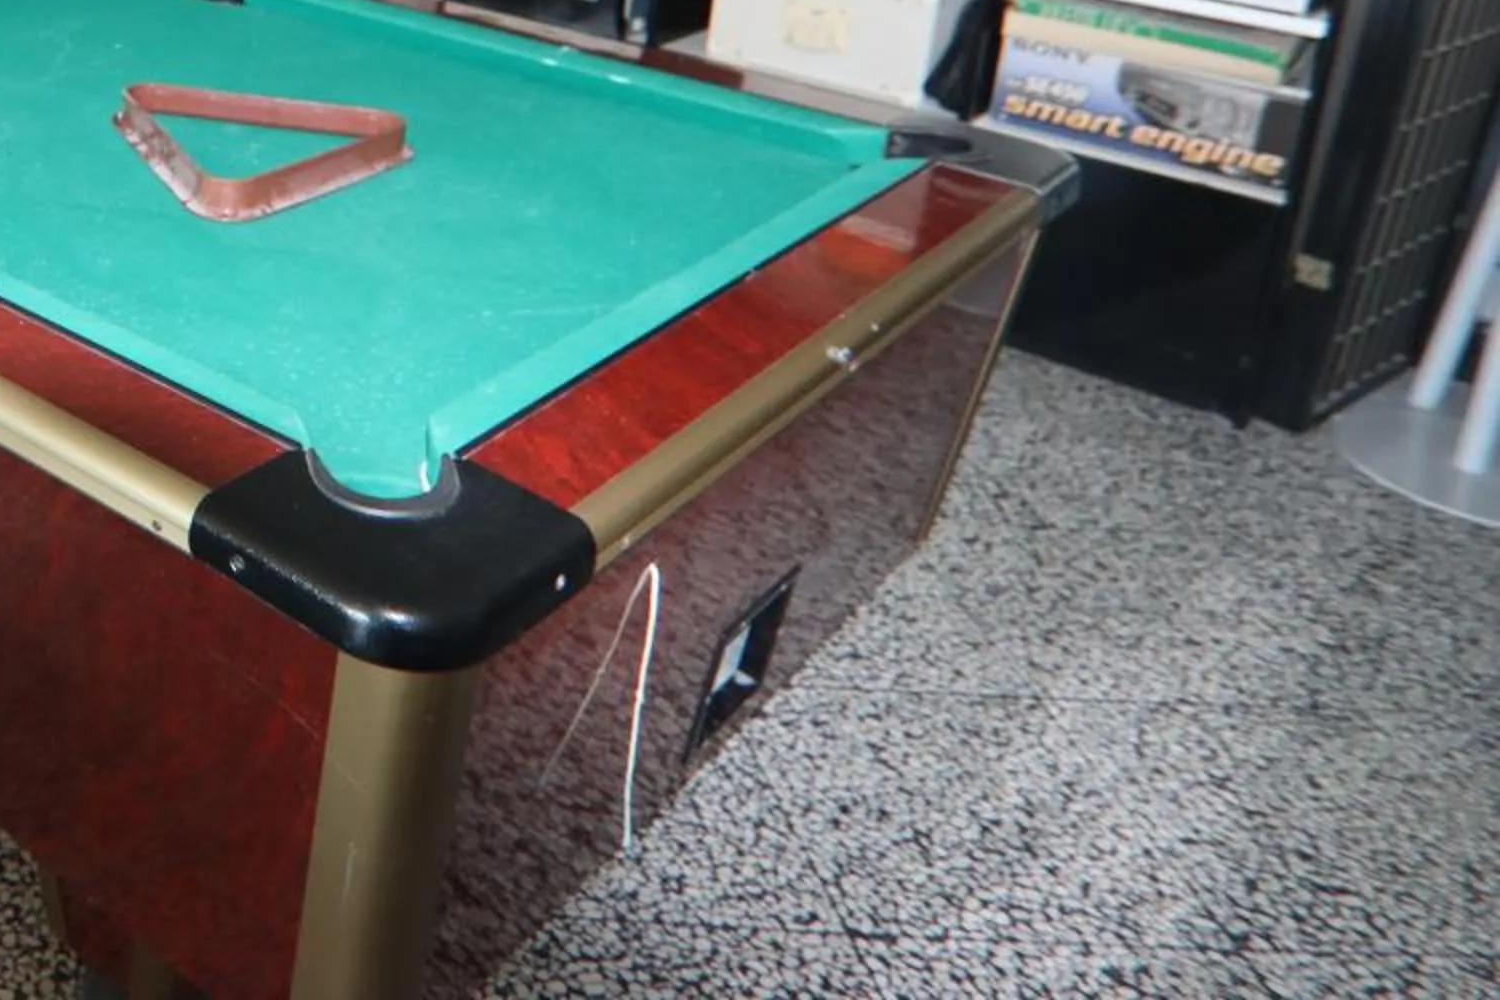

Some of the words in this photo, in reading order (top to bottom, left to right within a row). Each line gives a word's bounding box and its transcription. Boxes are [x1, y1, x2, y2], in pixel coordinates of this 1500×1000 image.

[1011, 35, 1091, 65] SONY
[1002, 94, 1127, 139] smart
[1129, 123, 1287, 177] engine
